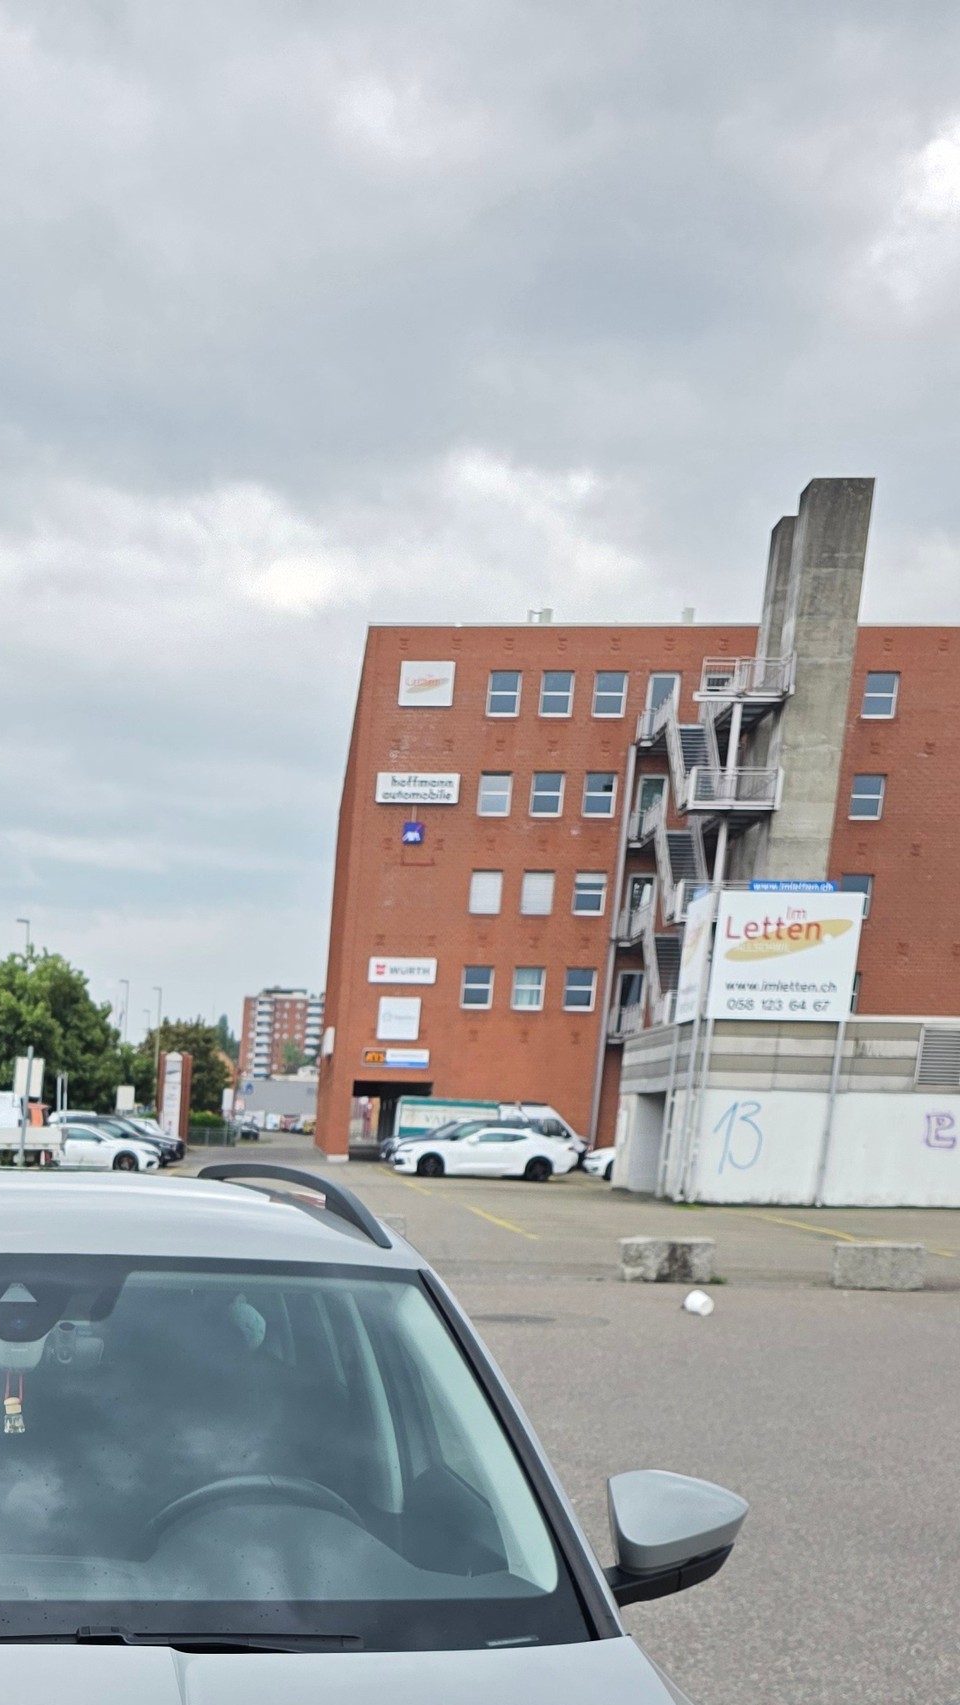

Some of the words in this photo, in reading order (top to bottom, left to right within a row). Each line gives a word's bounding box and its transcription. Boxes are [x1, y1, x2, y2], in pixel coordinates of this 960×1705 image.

[390, 775, 455, 788] hoffmann
[725, 915, 822, 941] Letten
[725, 980, 838, 993] www.imletten.ch
[762, 999, 784, 1011] 123
[789, 1000, 806, 1012] 64
